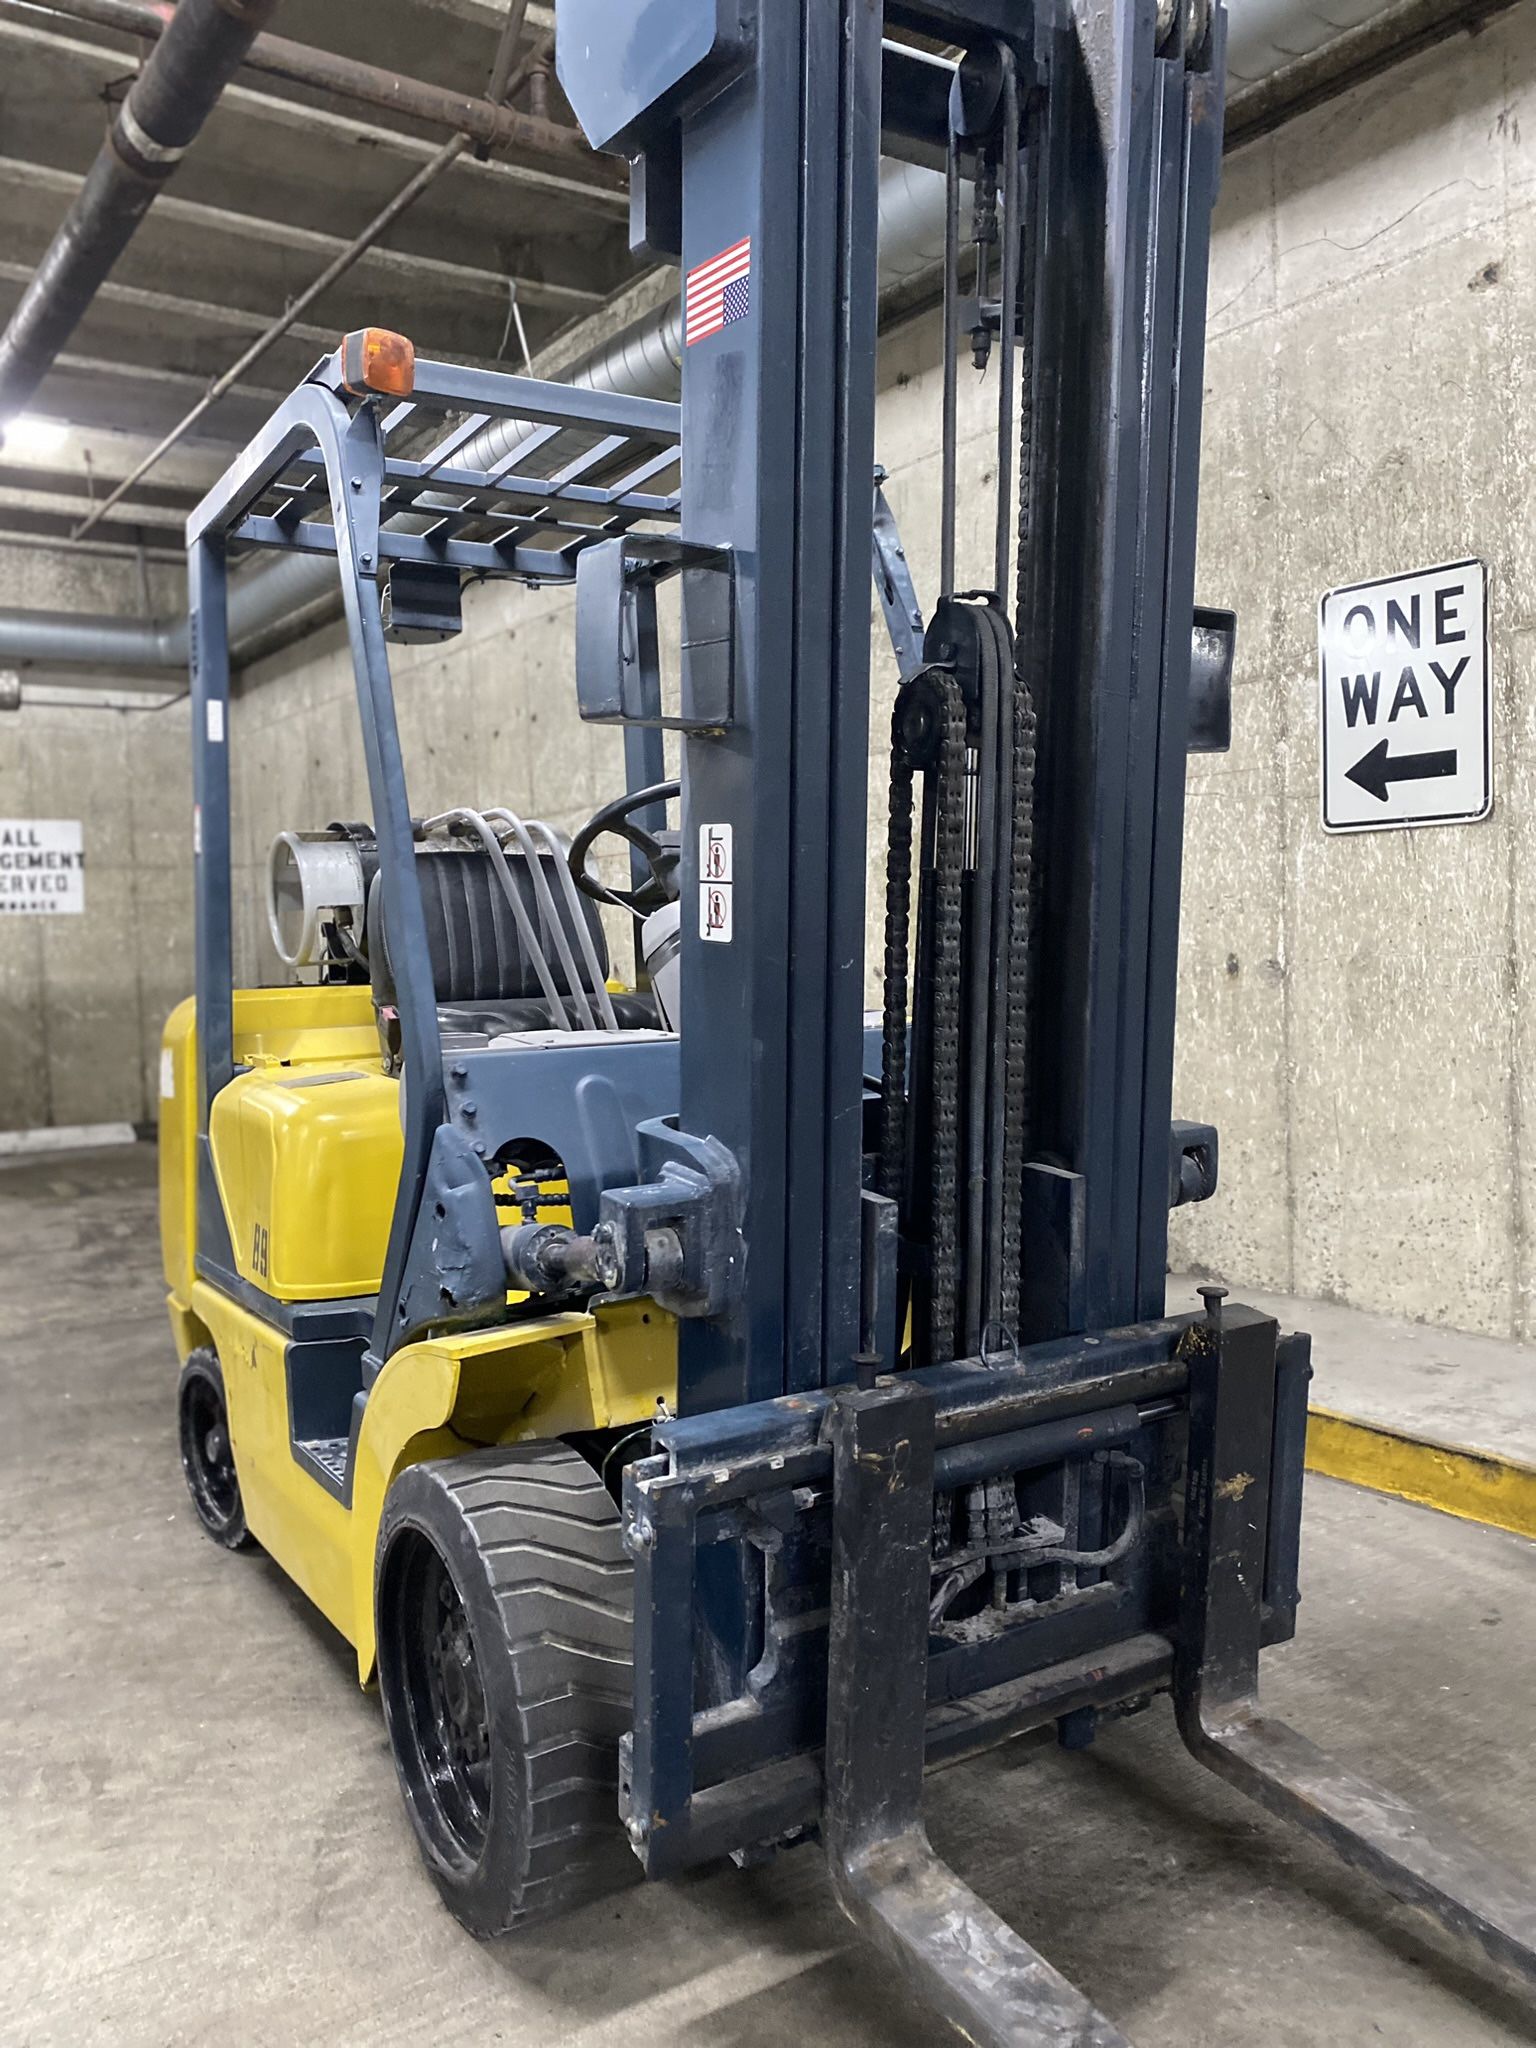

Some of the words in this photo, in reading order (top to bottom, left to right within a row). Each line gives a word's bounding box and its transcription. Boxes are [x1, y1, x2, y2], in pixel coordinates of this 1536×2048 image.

[1343, 585, 1466, 659] ONE
[1340, 656, 1471, 728] WAY
[2, 829, 41, 847] ALL
